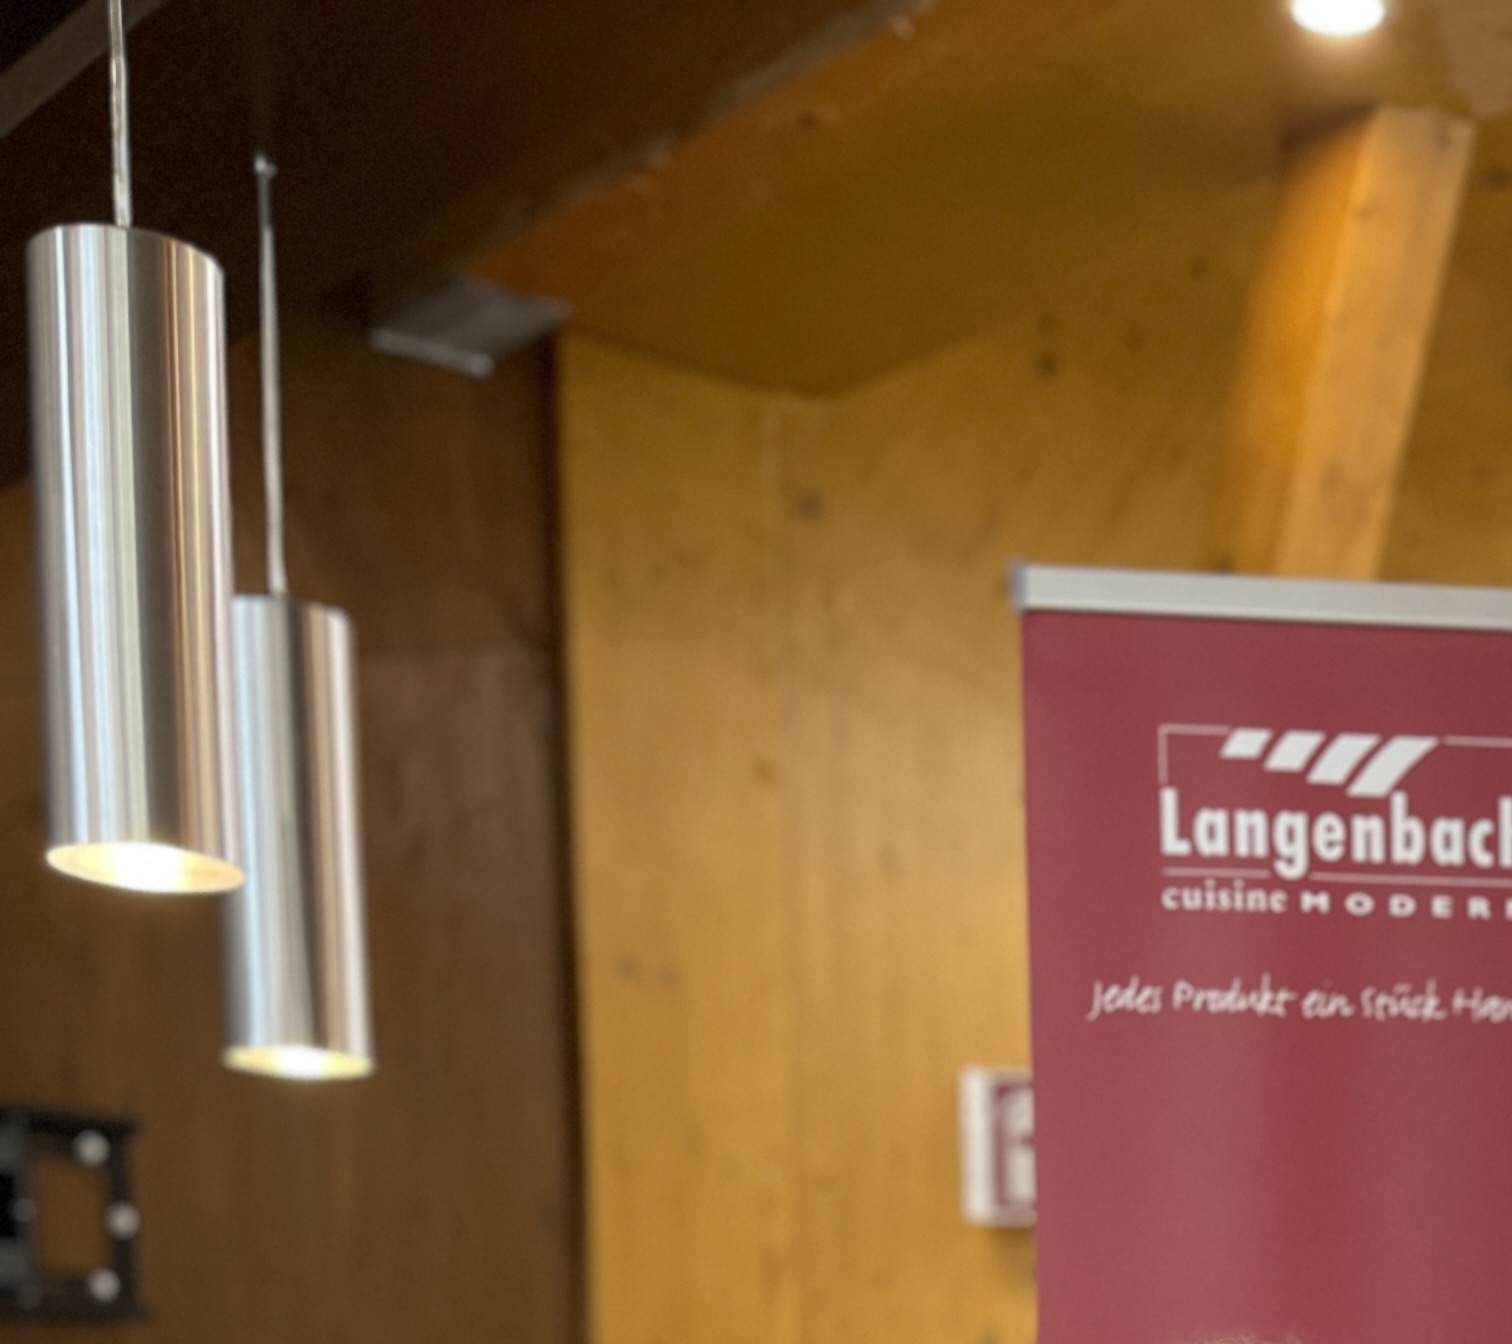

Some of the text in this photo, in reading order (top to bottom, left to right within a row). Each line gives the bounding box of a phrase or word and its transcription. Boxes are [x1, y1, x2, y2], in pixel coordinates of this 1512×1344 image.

[1161, 879, 1288, 914] cuisine
[1171, 971, 1297, 1018] Produkt
[1301, 977, 1355, 1020] ein
